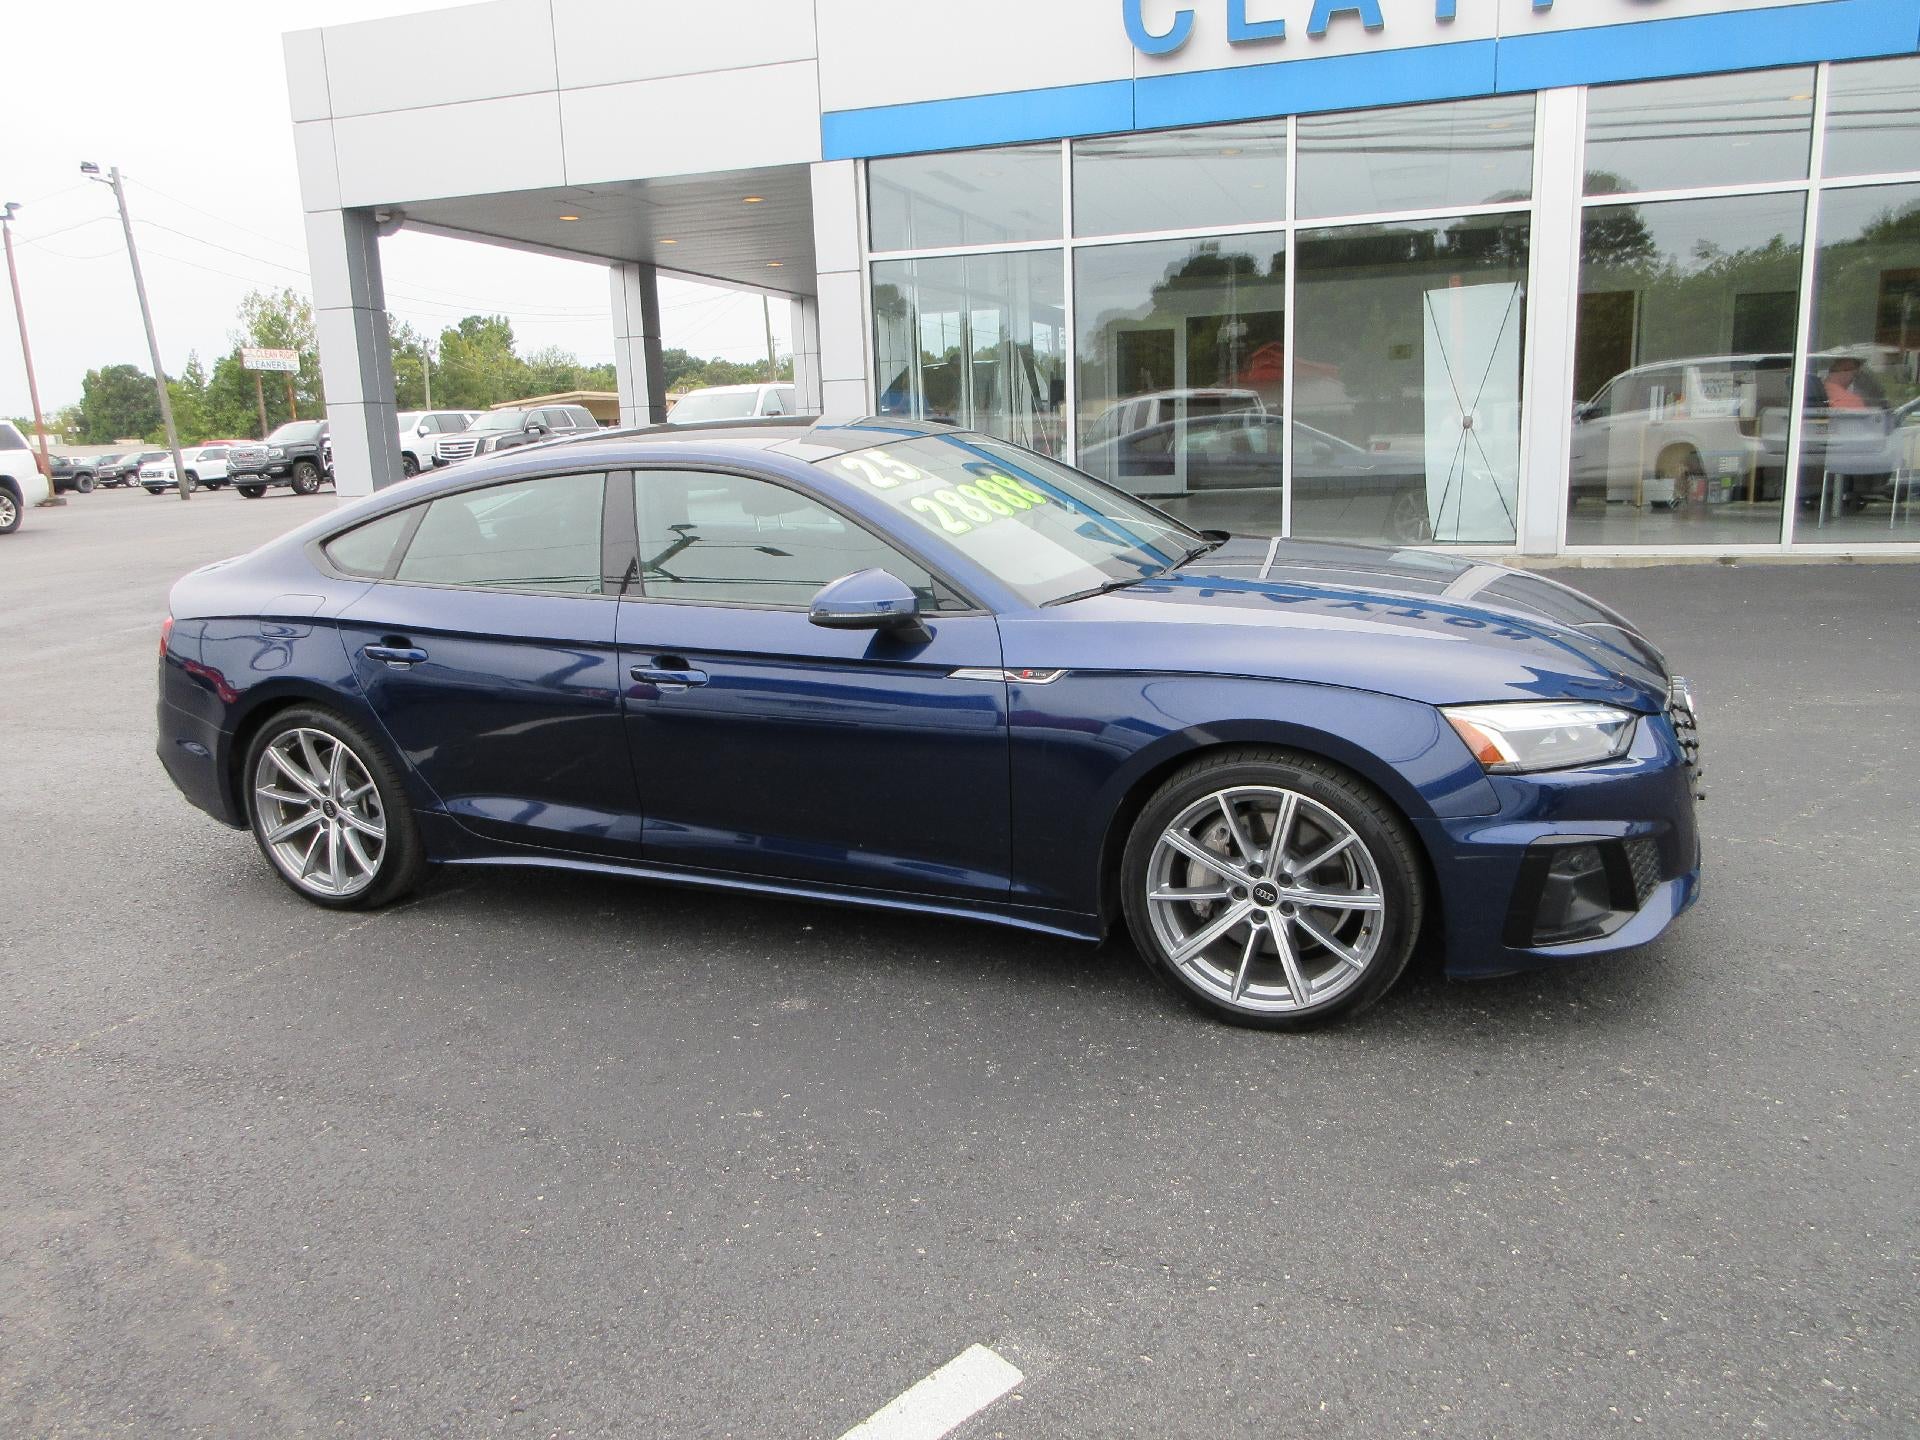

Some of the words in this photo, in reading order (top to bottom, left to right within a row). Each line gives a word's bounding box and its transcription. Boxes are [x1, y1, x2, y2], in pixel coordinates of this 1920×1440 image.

[244, 360, 288, 369] CLEANERS
[256, 349, 279, 359] CLEAN
[841, 450, 921, 488] 25
[910, 474, 1047, 535] 28888
